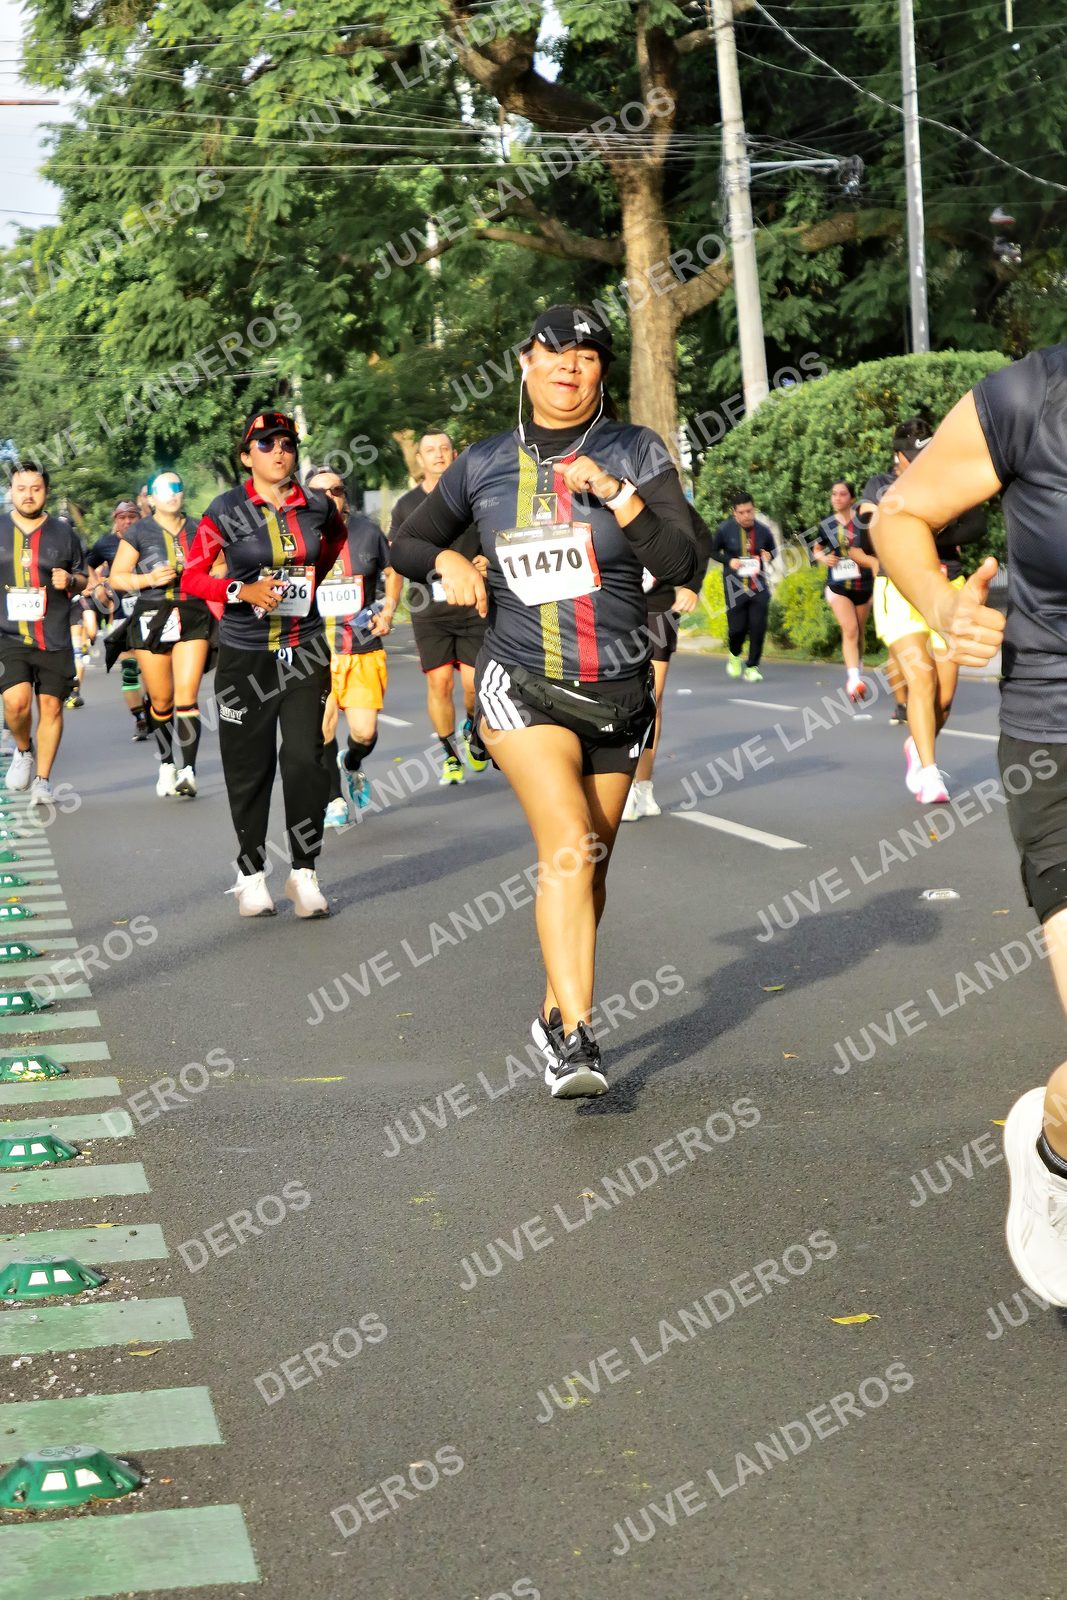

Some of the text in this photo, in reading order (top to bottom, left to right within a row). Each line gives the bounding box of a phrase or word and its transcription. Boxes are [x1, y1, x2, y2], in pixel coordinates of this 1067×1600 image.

[503, 547, 583, 579] 11470
[283, 584, 307, 599] 36
[320, 588, 357, 602] 11601
